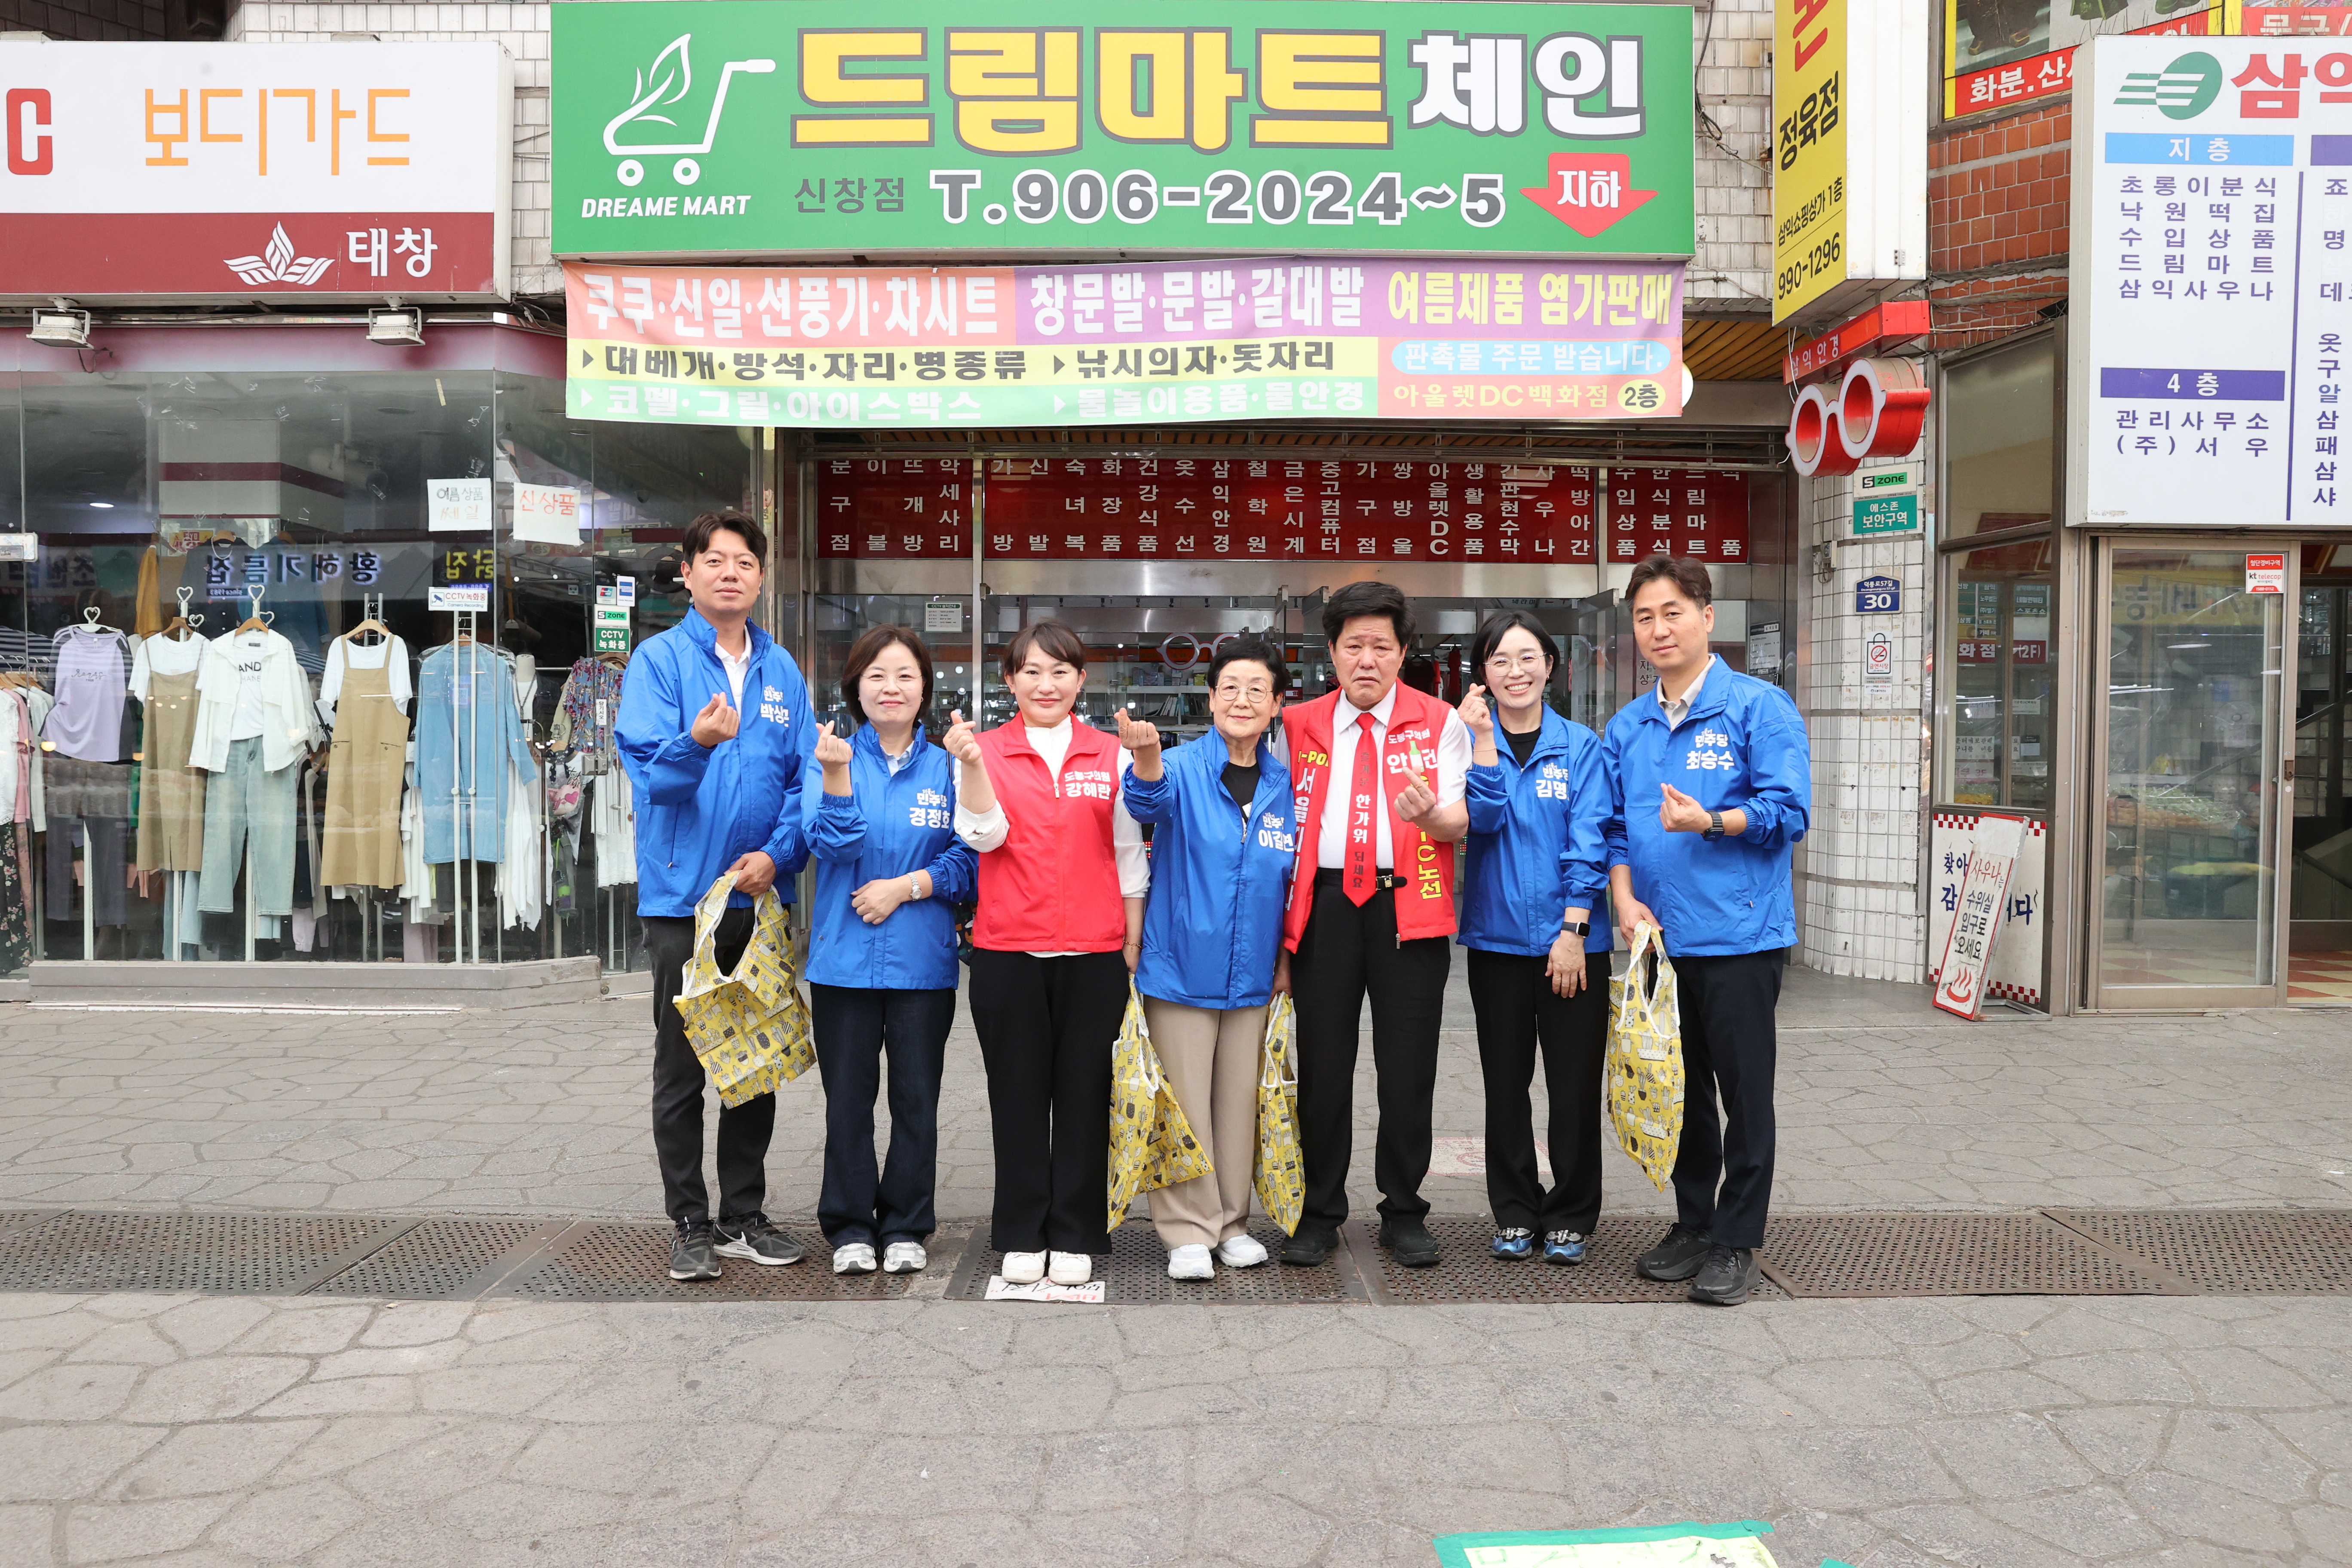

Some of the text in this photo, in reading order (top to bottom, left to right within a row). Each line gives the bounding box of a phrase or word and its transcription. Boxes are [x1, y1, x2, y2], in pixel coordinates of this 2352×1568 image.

[145, 89, 410, 176] 보디가드
[1779, 70, 1839, 171] 정육점
[581, 196, 752, 218] DREAME MART
[793, 168, 1507, 228] 신창점 T.906-2024~5
[1557, 171, 1621, 208] 지하
[2119, 176, 2276, 197] 초롱이분식
[346, 227, 438, 278] 태창
[1778, 232, 1840, 300] 990-1296
[1387, 270, 1523, 326] 여름제품
[1538, 271, 1672, 326] 염가판매
[2119, 278, 2274, 301] 삼익사우나
[1403, 342, 1482, 372] 판촉물
[1492, 343, 1544, 370] 주문
[1624, 385, 1660, 407] 2층
[2116, 410, 2269, 431] 관리사무소
[436, 487, 483, 502] 여름 상품
[519, 490, 576, 516] 신상품
[938, 459, 960, 551] 악세사리
[992, 459, 1014, 551] 가방
[1065, 459, 1086, 551] 숙녀복
[1101, 459, 1123, 552] 화장품
[1137, 459, 1159, 552] 건강식품
[1174, 459, 1196, 552] 옷수선
[1211, 460, 1230, 553] 삼익안경
[1247, 460, 1268, 553] 철학원
[1283, 461, 1305, 554] 금은시계
[1320, 461, 1341, 554] 중고컴퓨터
[1356, 462, 1378, 554] 가구점
[1392, 462, 1414, 554] 쌍방울
[1428, 462, 1449, 555] 아울렛DC
[1464, 463, 1485, 554] 생활용품
[1499, 464, 1520, 555] 간판현수막
[1534, 466, 1556, 556] 사우나
[1862, 511, 1908, 528] 보안구역
[1870, 501, 1899, 513] 에스존
[1864, 594, 1891, 609] 30
[599, 640, 626, 649] 녹화중
[601, 630, 624, 639] CCTV
[1298, 750, 1329, 767] -PO
[1387, 728, 1431, 744] 도봉구의원
[1686, 749, 1735, 771] 최승수
[1694, 733, 1728, 748] 민주당
[916, 793, 947, 808] 민주당
[1064, 770, 1111, 782] 도봉구의원
[1536, 779, 1570, 801] 김명
[1353, 794, 1371, 844] 한가위
[1962, 912, 1987, 936] 입구로
